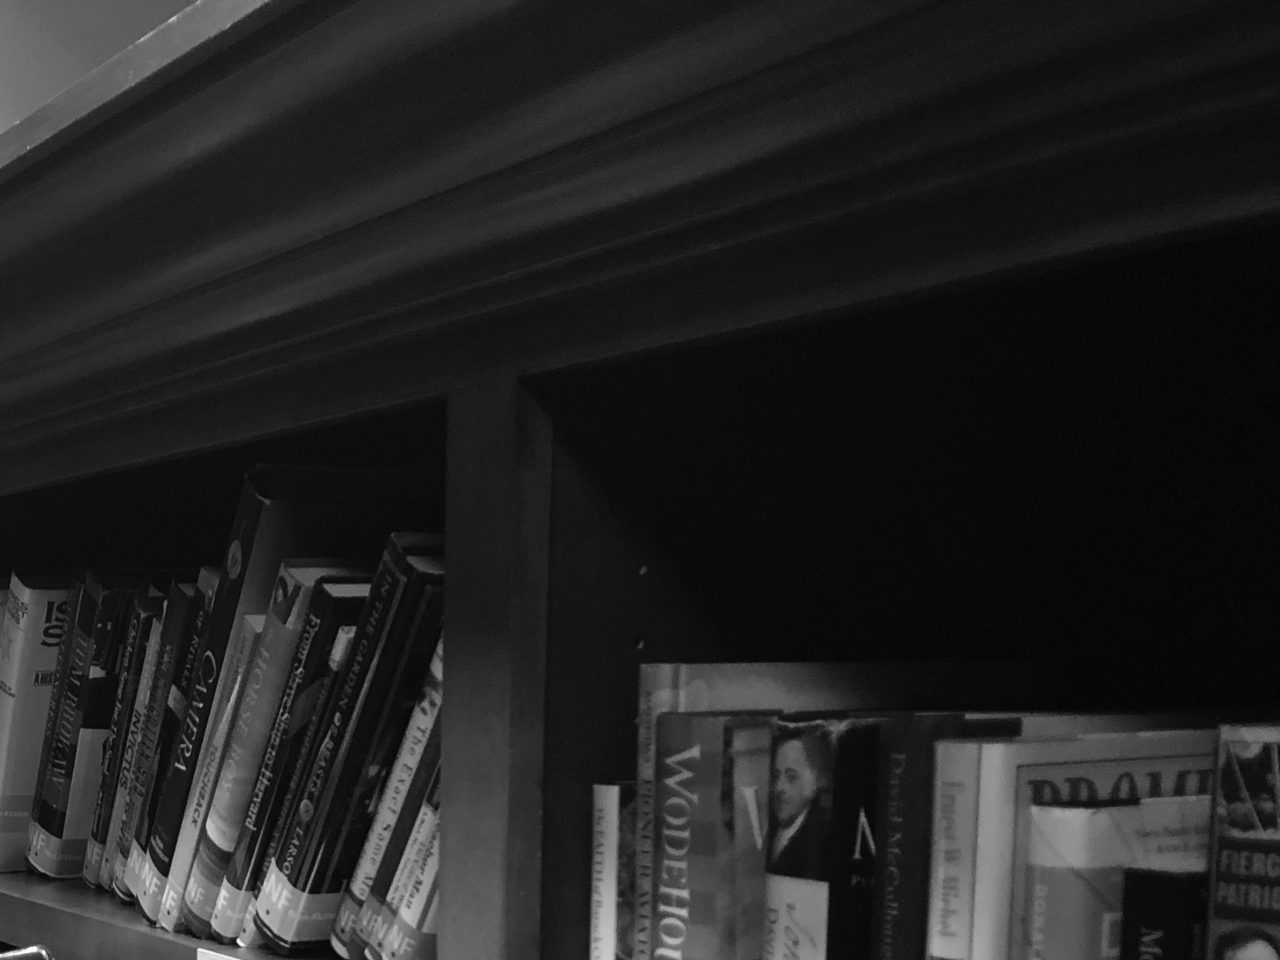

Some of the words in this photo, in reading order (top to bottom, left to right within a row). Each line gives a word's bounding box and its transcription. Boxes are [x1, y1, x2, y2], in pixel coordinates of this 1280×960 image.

[118, 709, 143, 790] INVICTUS
[242, 767, 273, 831] Harvard
[279, 825, 304, 877] LARSO
[1219, 849, 1280, 878] FIERC
[1217, 880, 1280, 910] PATRIO
